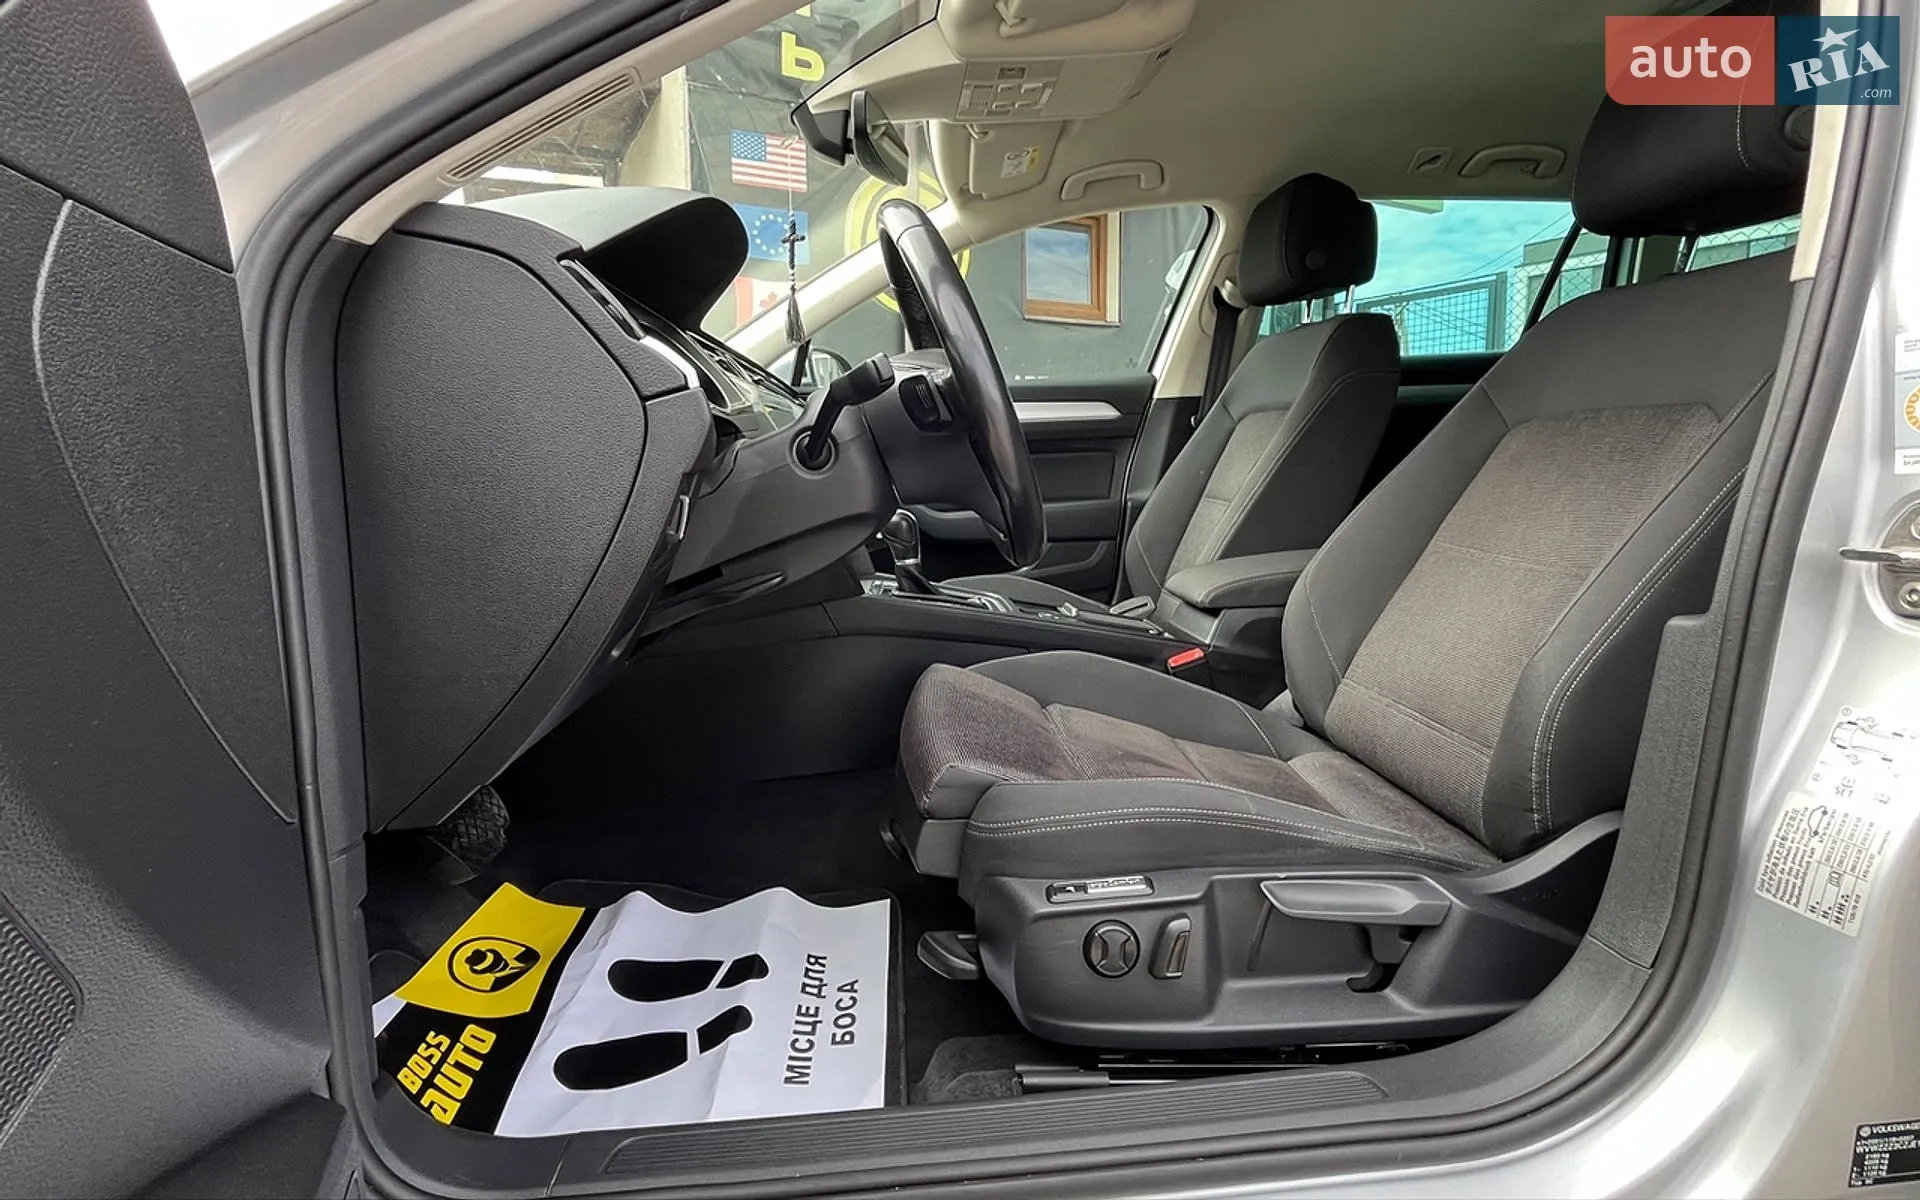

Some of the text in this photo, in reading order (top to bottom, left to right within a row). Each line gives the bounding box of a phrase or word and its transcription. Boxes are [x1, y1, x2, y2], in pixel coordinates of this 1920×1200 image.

[784, 953, 828, 1086] МІСЦЕ ДЛЯ
[831, 978, 859, 1046] БОСА
[396, 1030, 452, 1095] BOSS
